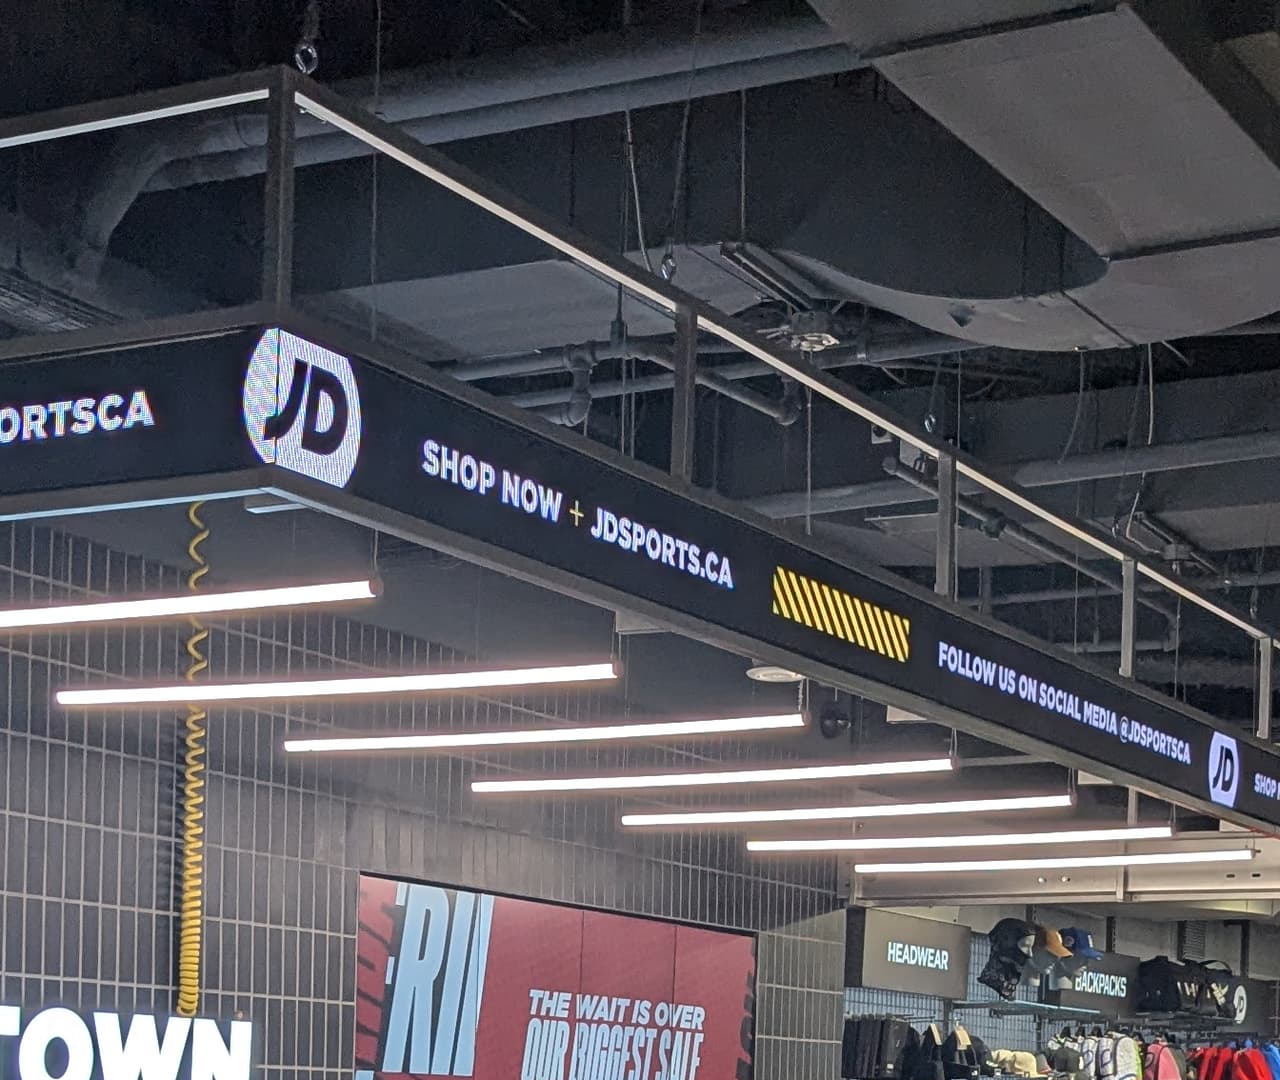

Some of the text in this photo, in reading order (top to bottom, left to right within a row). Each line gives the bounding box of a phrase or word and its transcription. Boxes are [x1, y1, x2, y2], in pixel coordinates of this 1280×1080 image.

[422, 439, 496, 495] SHOP
[502, 470, 563, 522] NOW
[591, 507, 734, 589] JDSPORTS.CA
[938, 641, 1191, 764] FOLLOW US ON SOCIAL MEDIA @JDSPORTSCA
[1254, 773, 1277, 798] SHOP
[887, 942, 949, 970] HEADWEAR
[1075, 971, 1127, 998] BACKPACKS
[529, 989, 705, 1030] THE WAIT IS OVER
